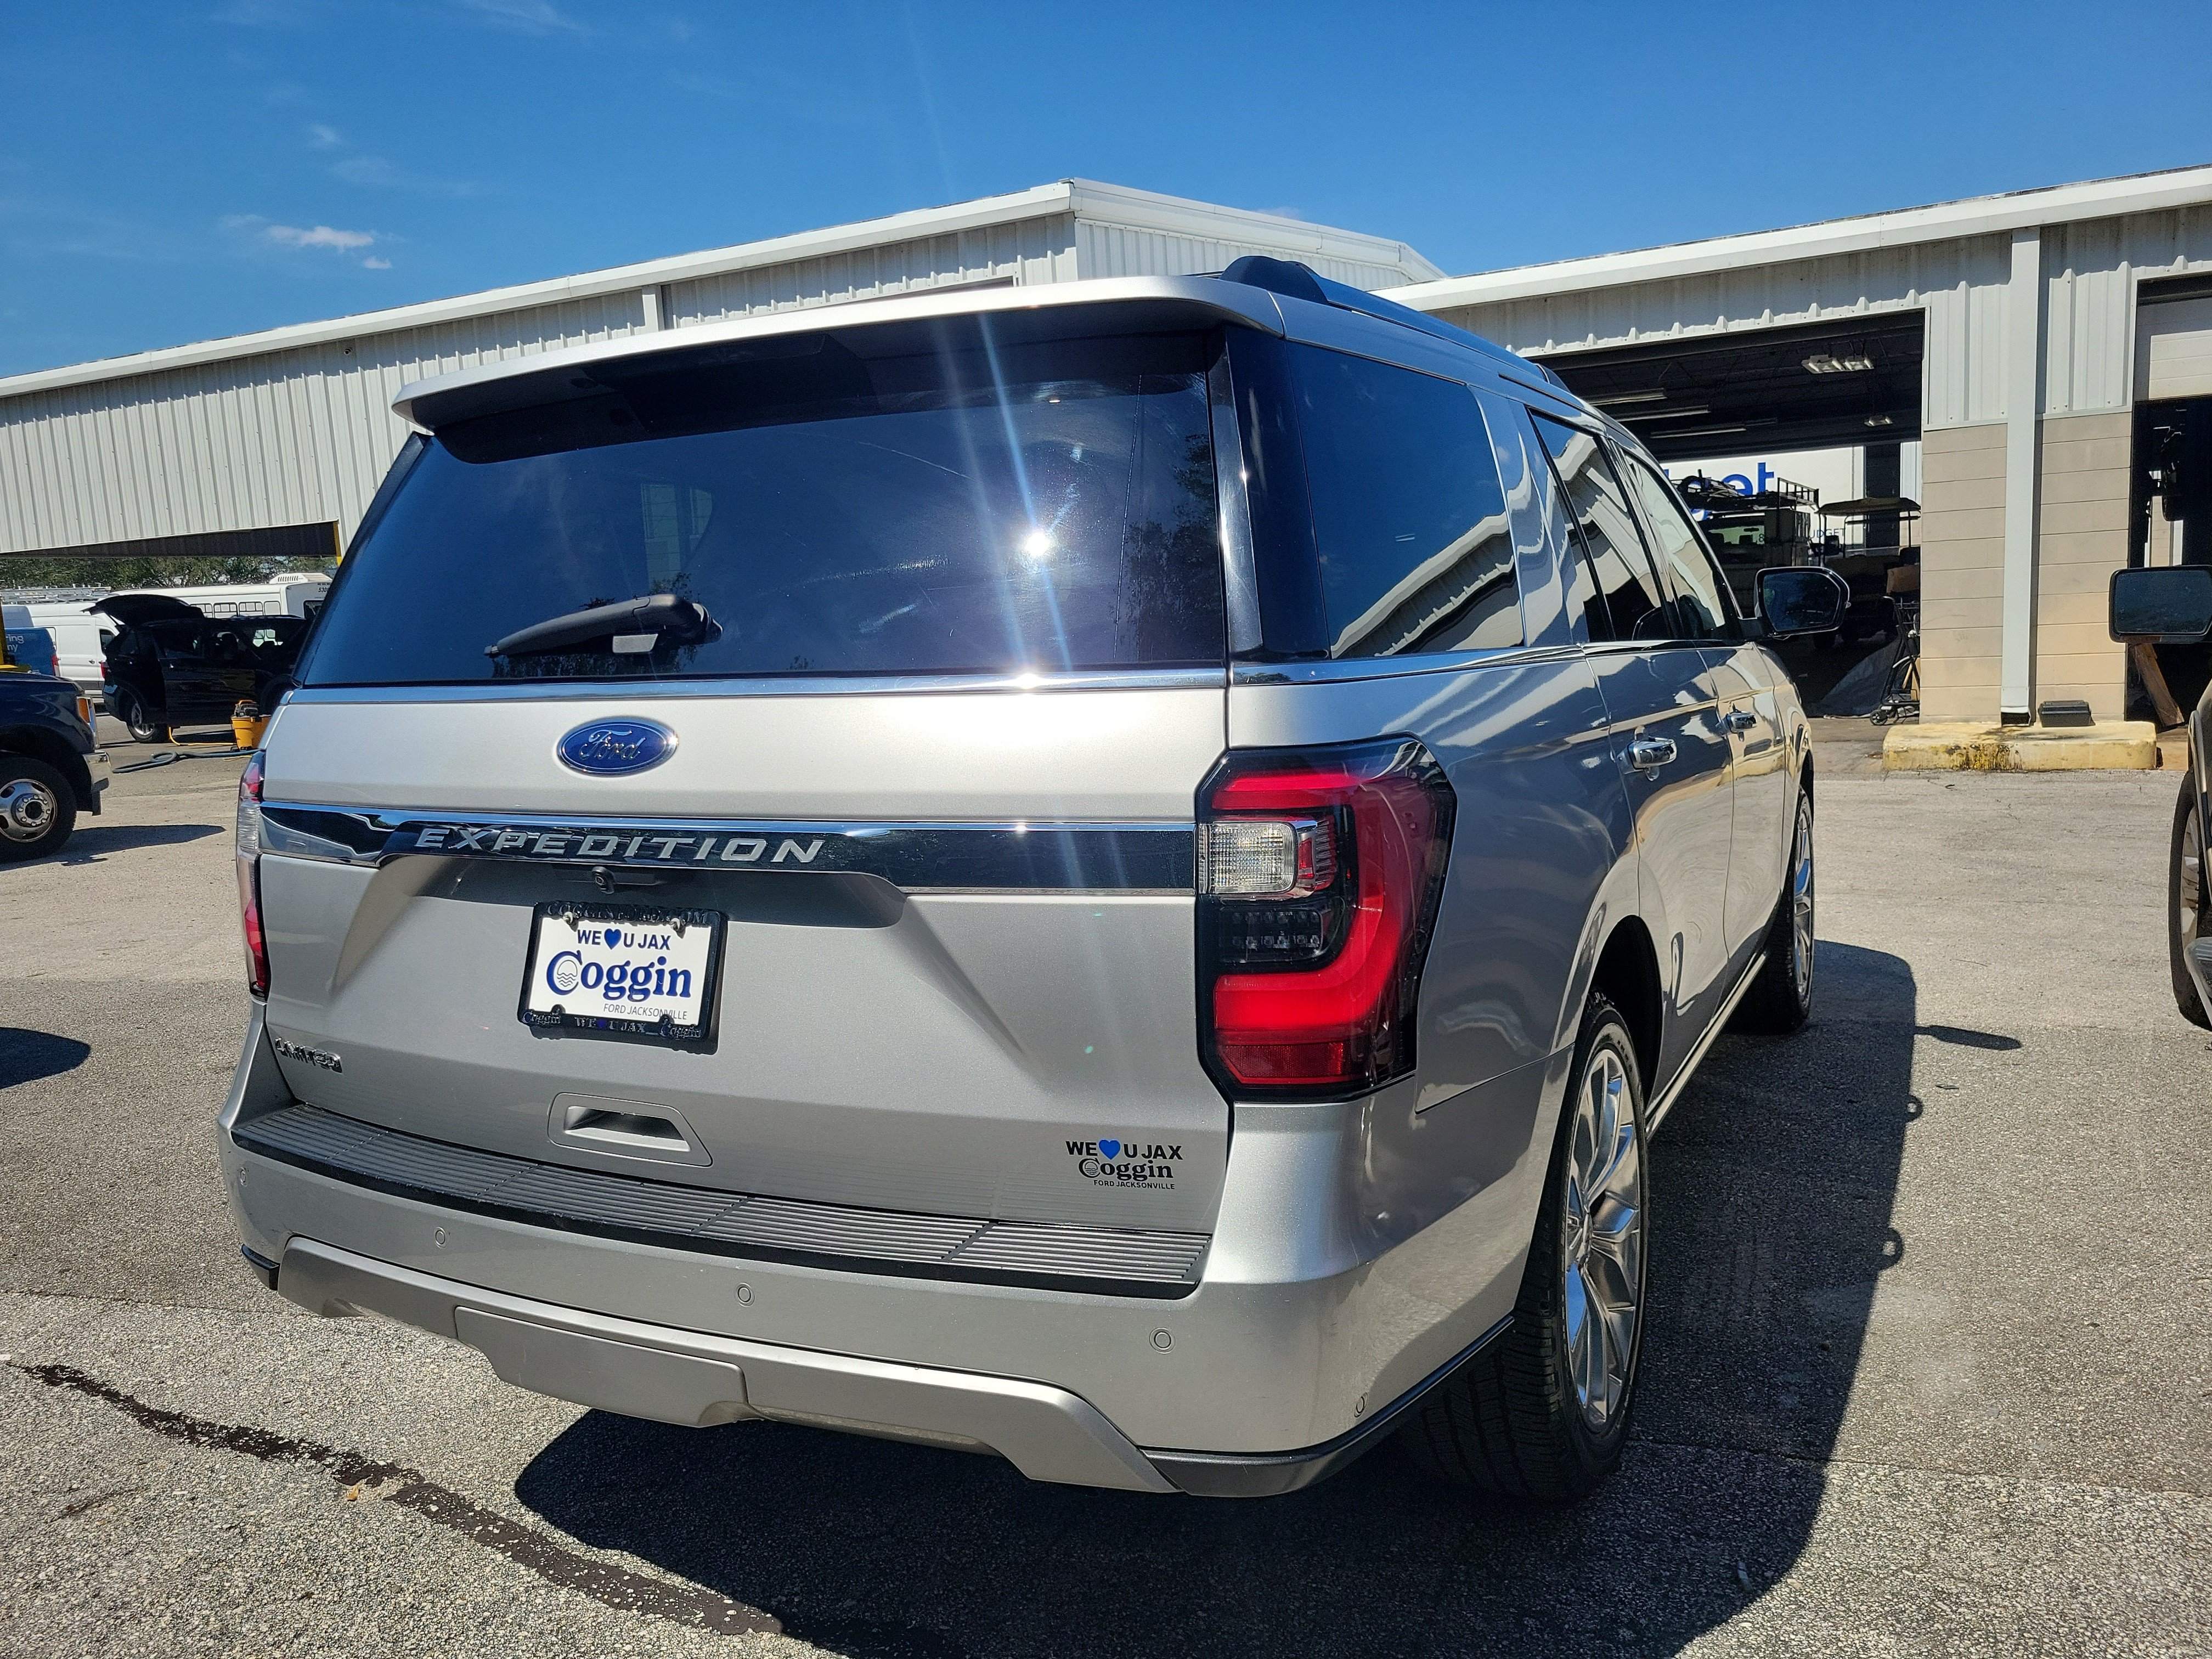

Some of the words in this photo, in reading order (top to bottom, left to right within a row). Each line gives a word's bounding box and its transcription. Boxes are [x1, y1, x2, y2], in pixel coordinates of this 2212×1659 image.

[579, 729, 647, 760] Ford
[414, 827, 826, 864] EXPEDITION
[577, 929, 602, 945] WE
[623, 933, 635, 948] U
[637, 934, 672, 950] JAX
[546, 950, 691, 1002] Coggin
[603, 1003, 626, 1013] FORD
[627, 1006, 688, 1020] JACKSONVILLE
[574, 1017, 596, 1028] WE
[620, 1021, 646, 1032] JAX
[1065, 1141, 1098, 1156] WE
[1124, 1144, 1138, 1158] U
[1141, 1144, 1183, 1160] JAX
[1078, 1158, 1173, 1182] Coggin
[1116, 1181, 1175, 1189] JACKSONVILLE
